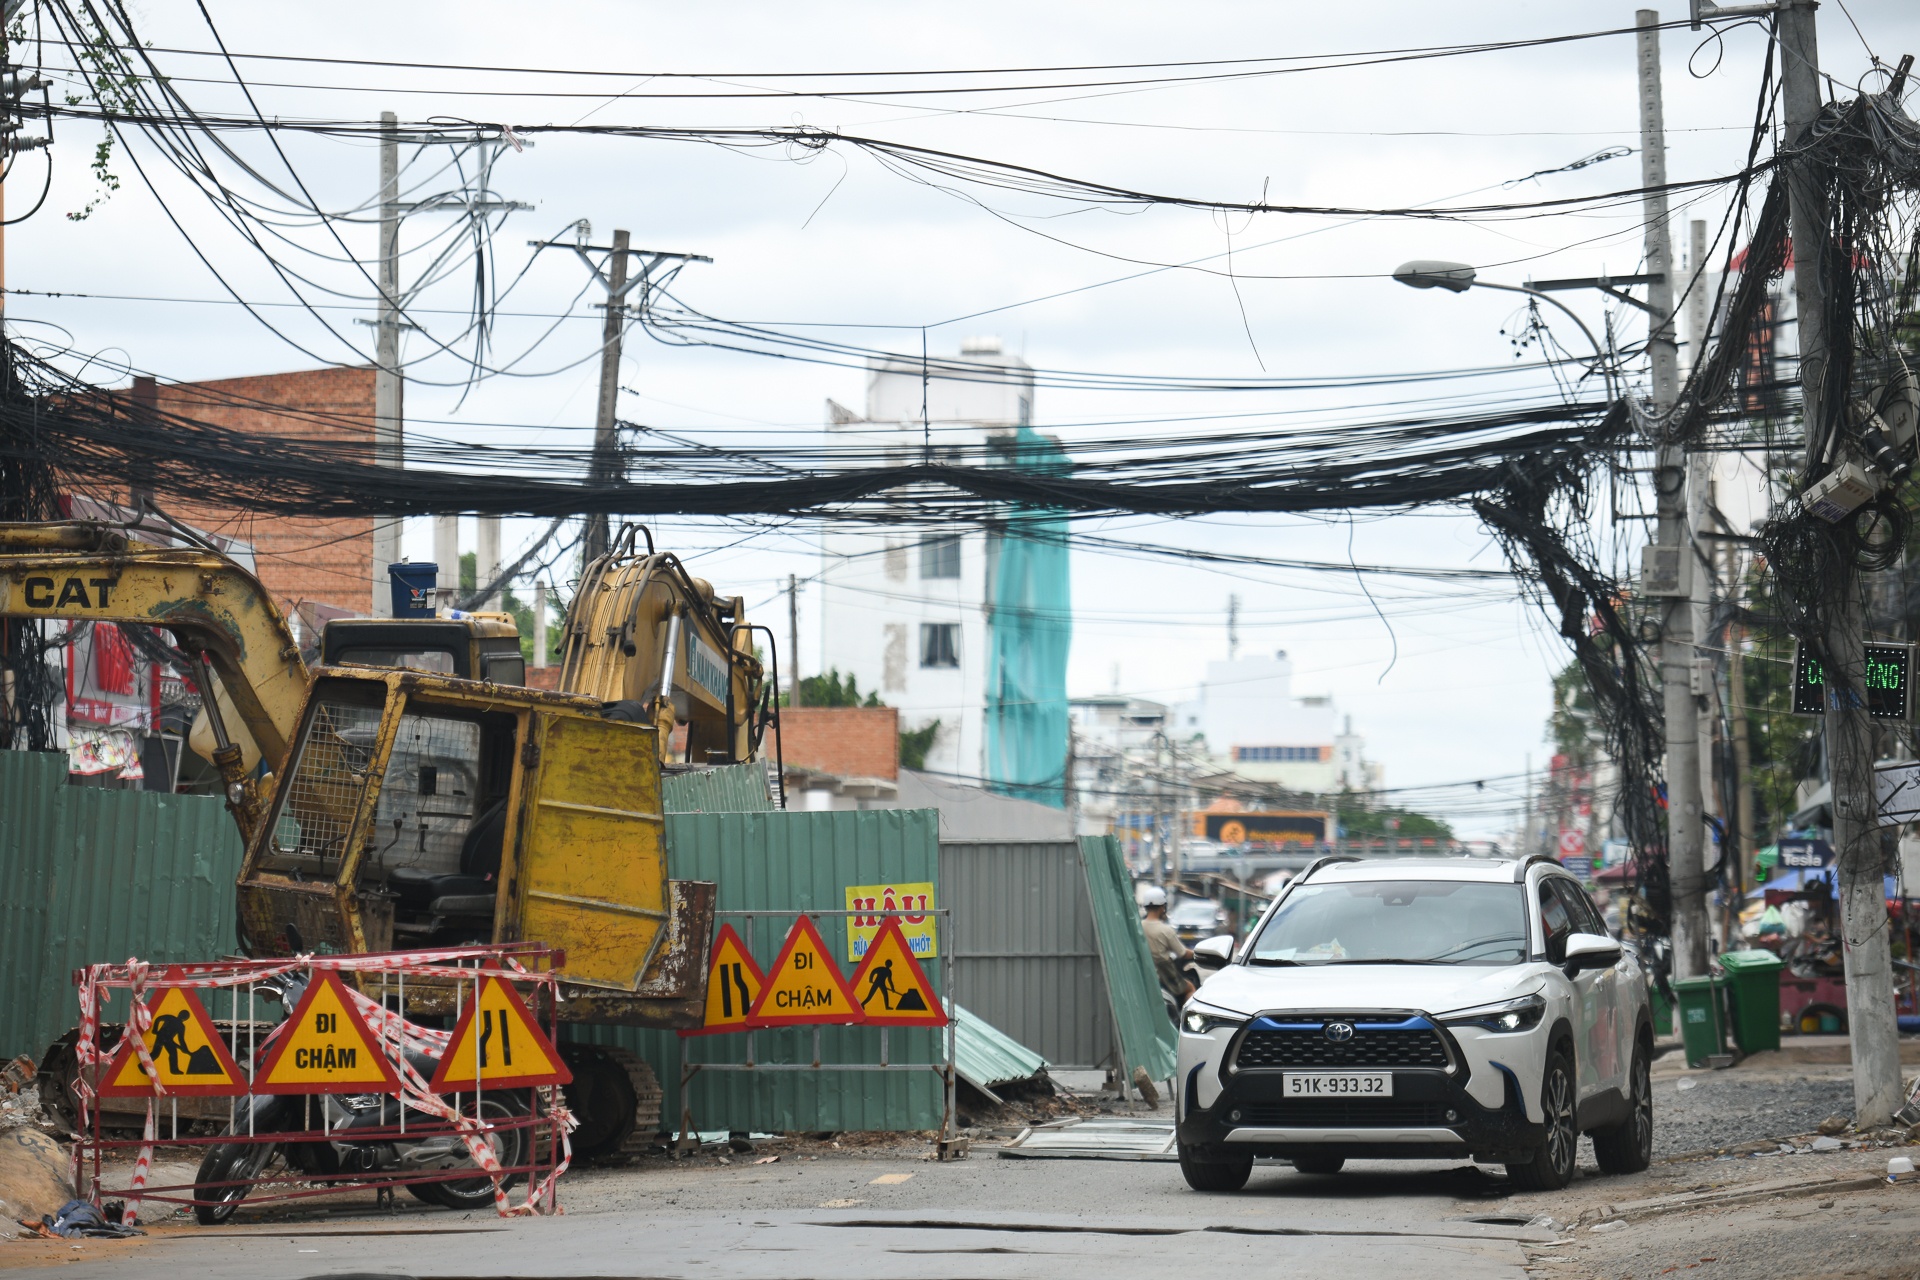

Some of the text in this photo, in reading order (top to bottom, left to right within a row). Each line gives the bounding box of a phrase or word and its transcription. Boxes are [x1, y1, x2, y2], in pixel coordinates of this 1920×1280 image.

[25, 577, 117, 608] CAT
[1783, 853, 1822, 866] Tesla
[793, 952, 813, 970] ĐI
[775, 984, 832, 1010] CHẬM
[315, 1013, 337, 1034] ĐI
[294, 1043, 357, 1073] CHẬM
[1292, 1077, 1384, 1093] 51K-933.32
